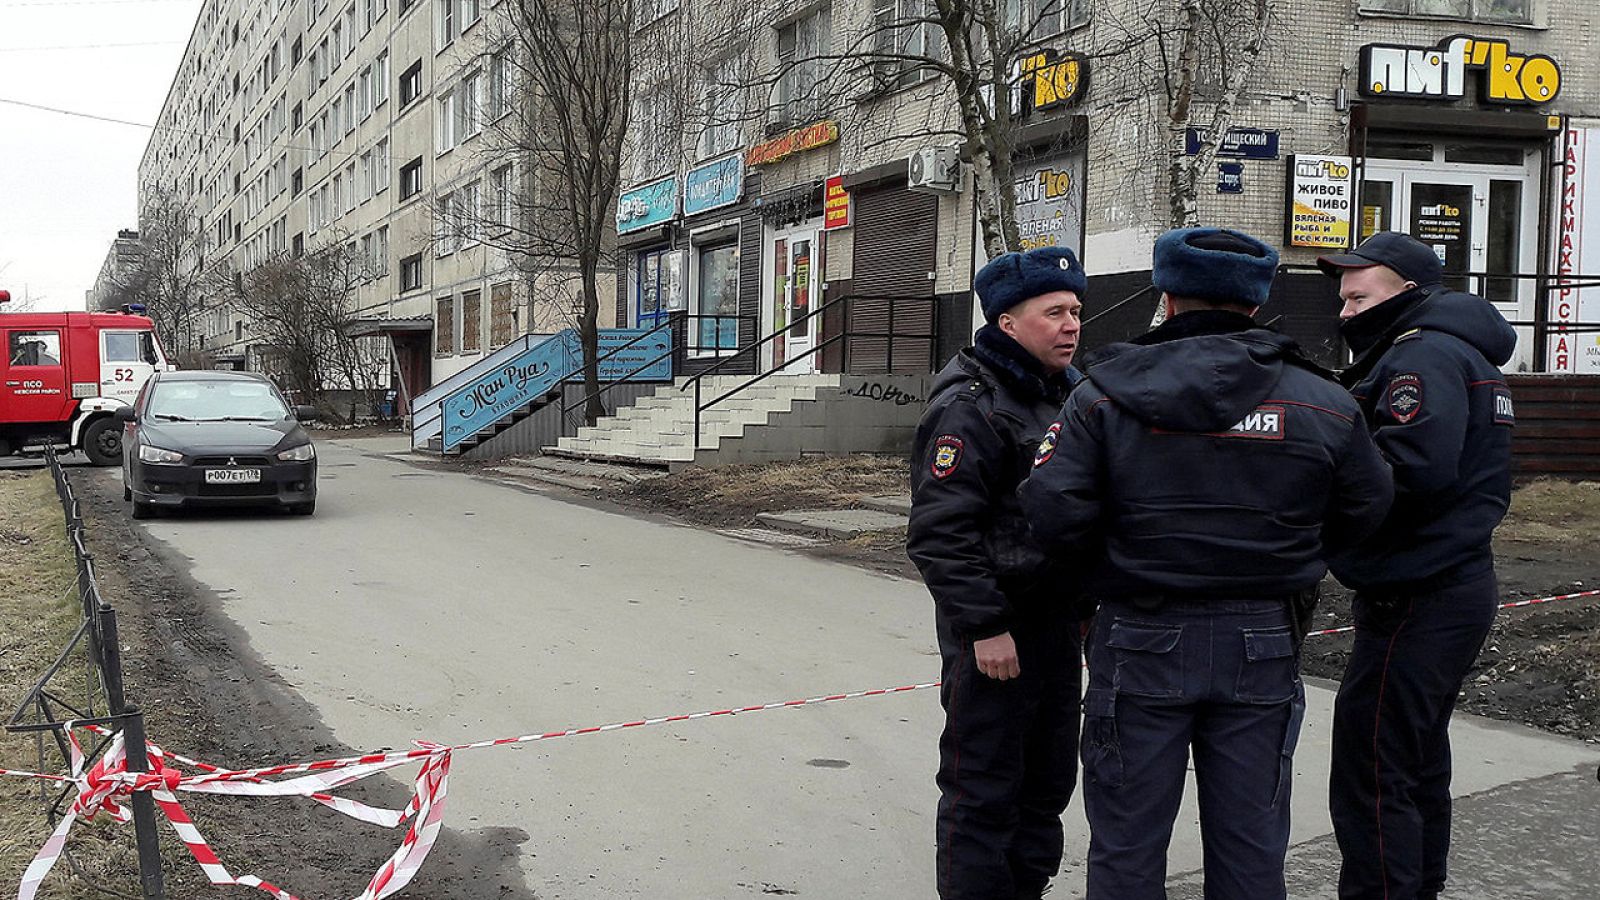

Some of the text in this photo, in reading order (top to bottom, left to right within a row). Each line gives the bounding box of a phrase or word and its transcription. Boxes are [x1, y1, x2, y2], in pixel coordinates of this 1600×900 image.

[1195, 129, 1267, 146] ТОИЩЕСКИЙ
[1298, 184, 1344, 195] ЖИВОЕ
[1314, 199, 1348, 210] ПИВО
[1294, 214, 1336, 223] ВЯЛЕНАЯ
[1294, 223, 1320, 232] РЫБА
[114, 368, 134, 381] 52
[23, 380, 43, 388] ПСО
[459, 362, 550, 418] Жан Руа
